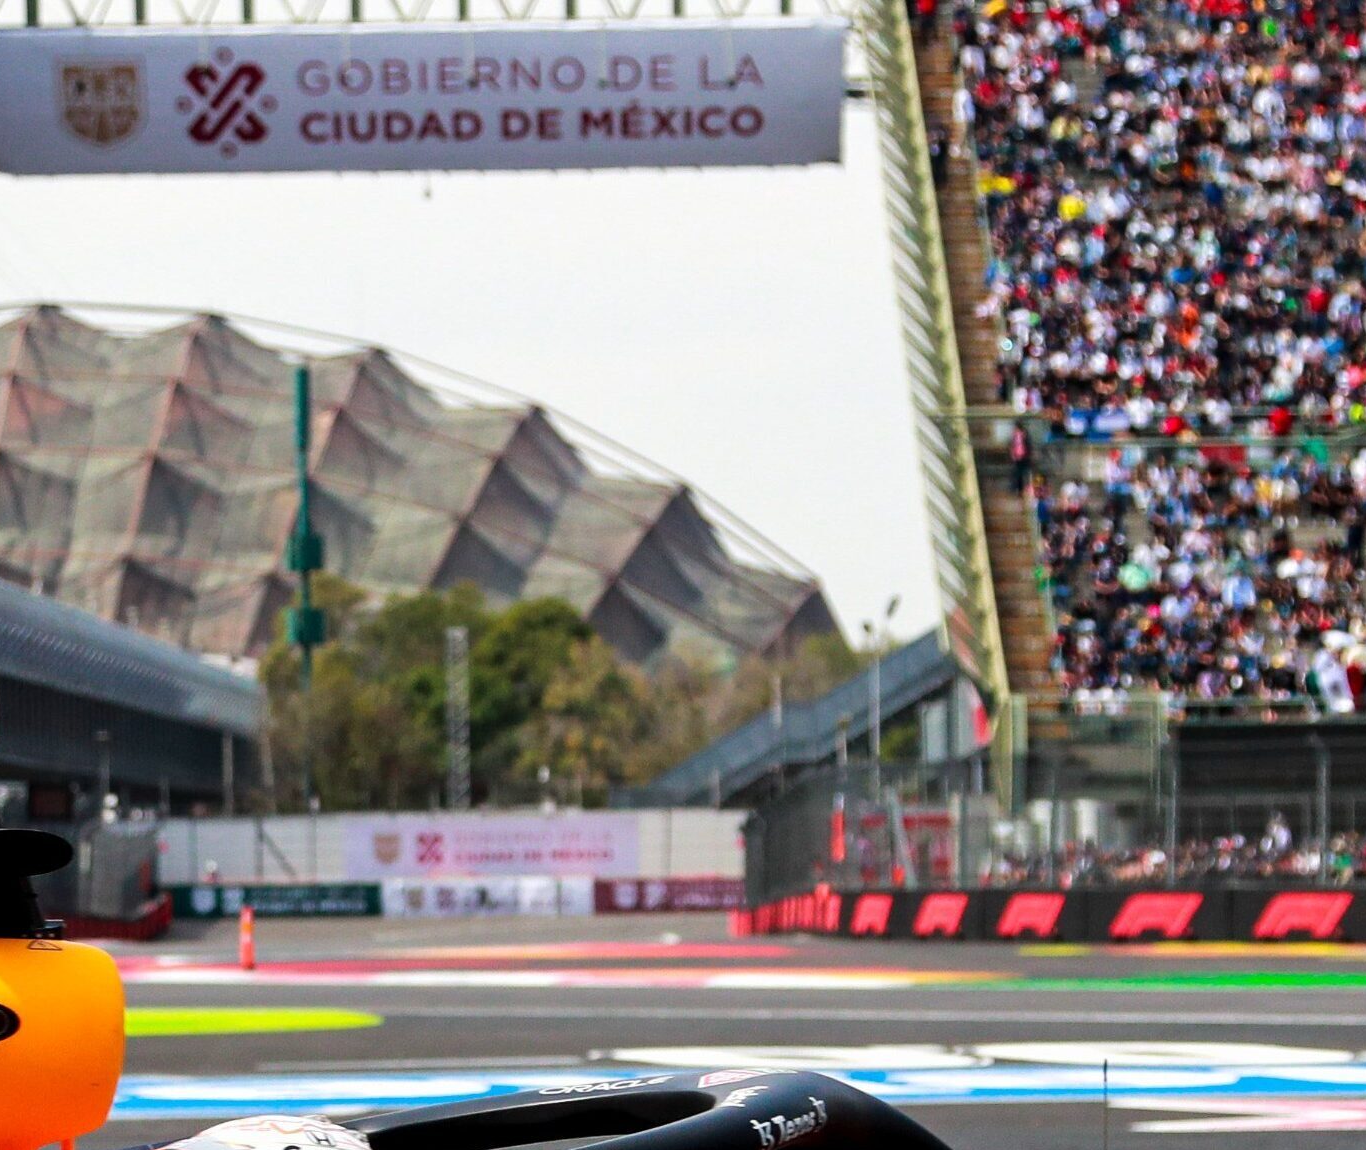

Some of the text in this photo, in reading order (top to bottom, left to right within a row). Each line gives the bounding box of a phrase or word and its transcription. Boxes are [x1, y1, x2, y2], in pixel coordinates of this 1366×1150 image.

[295, 52, 766, 98] GOBIERNO DE LA
[299, 99, 766, 145] CIUDAD DE MÉXICO
